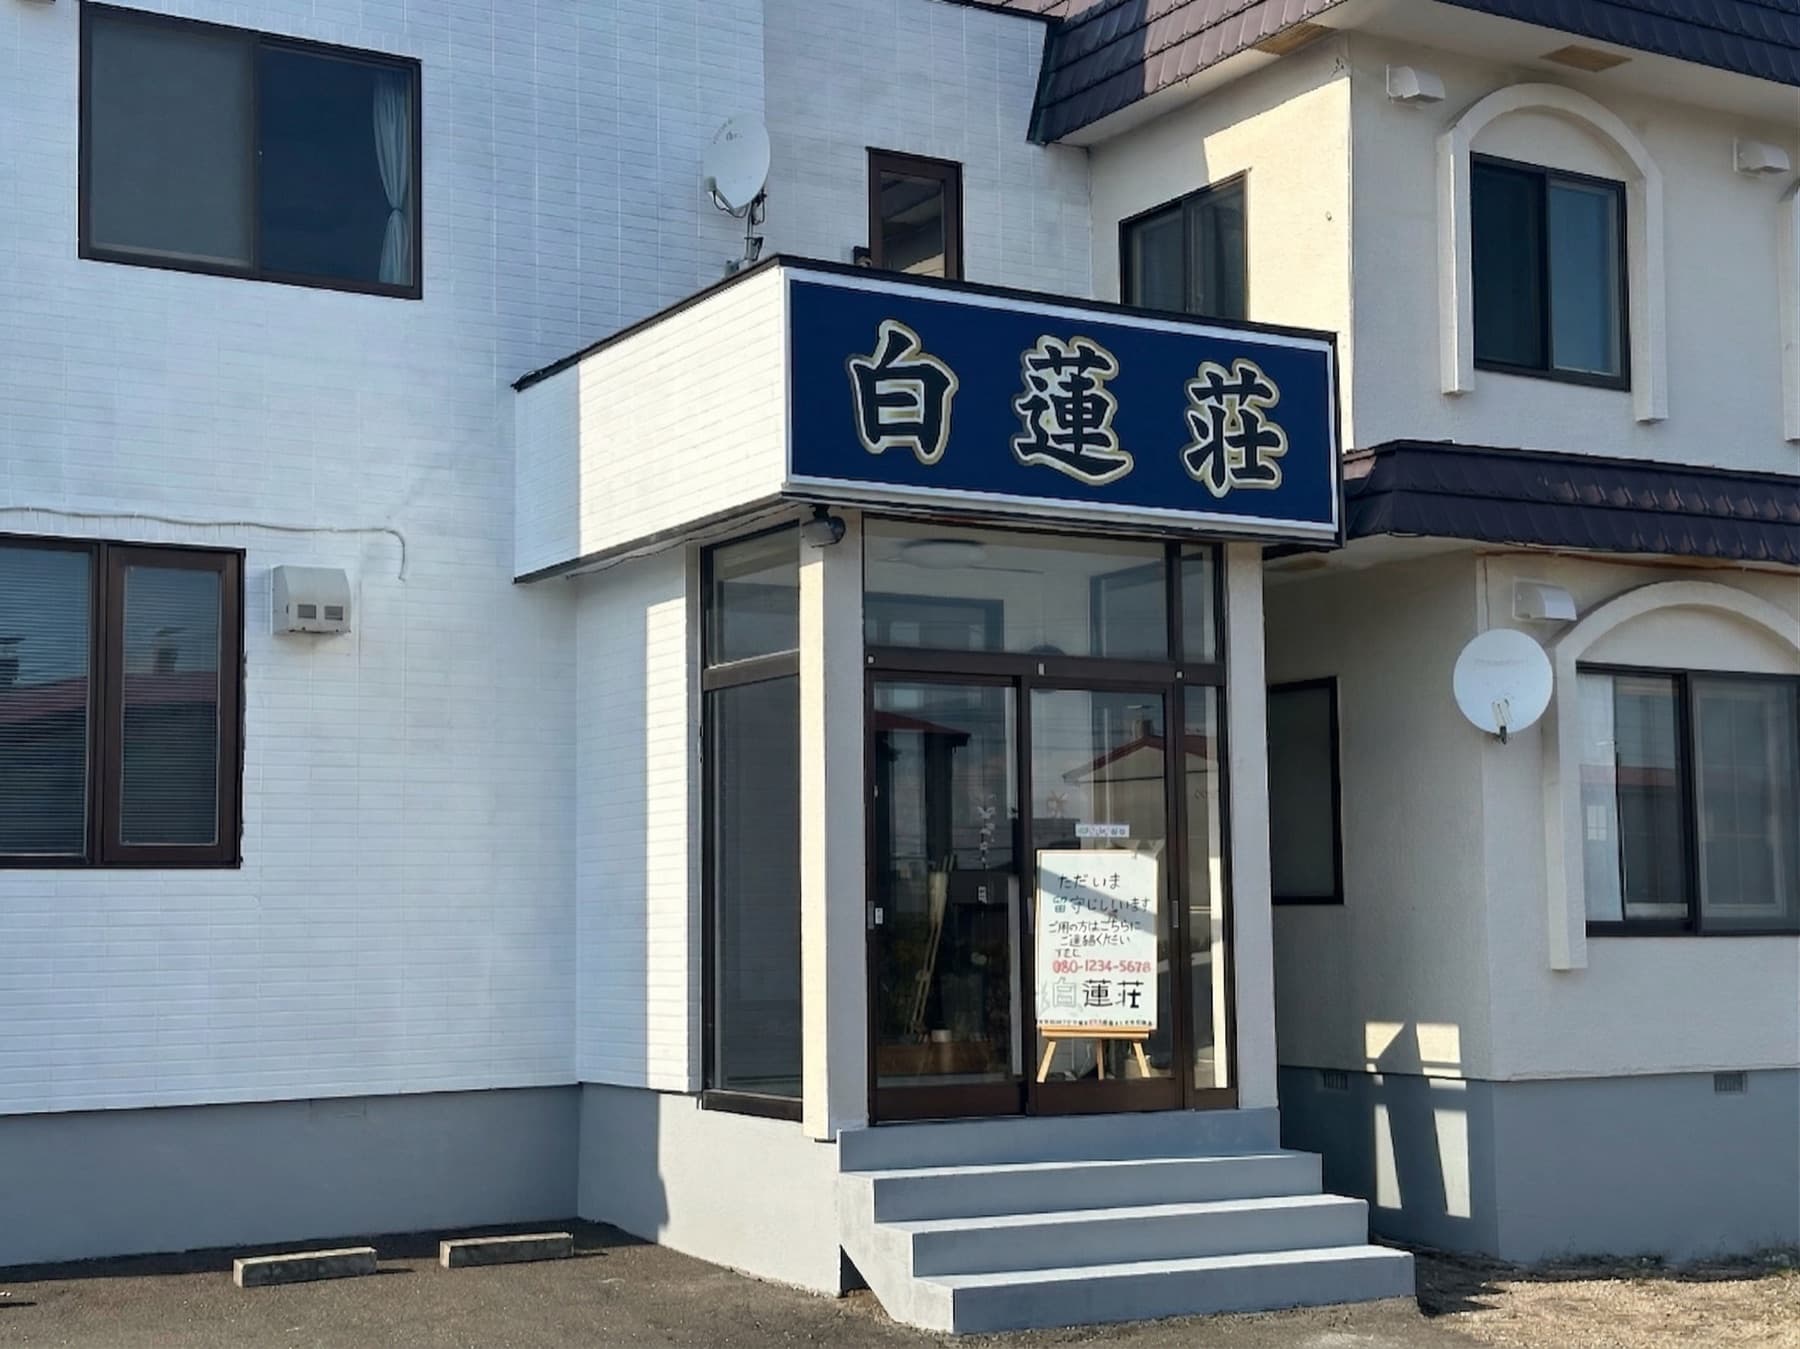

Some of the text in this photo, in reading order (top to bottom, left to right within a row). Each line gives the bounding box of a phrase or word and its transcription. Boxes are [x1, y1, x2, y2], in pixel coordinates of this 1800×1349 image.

[847, 319, 1288, 498] 白蓮荘
[1057, 872, 1120, 889] ただいま
[1055, 948, 1081, 958] TEL
[1052, 959, 1152, 974] 080-1234-5678
[1052, 976, 1144, 1009] 白蓮荘
